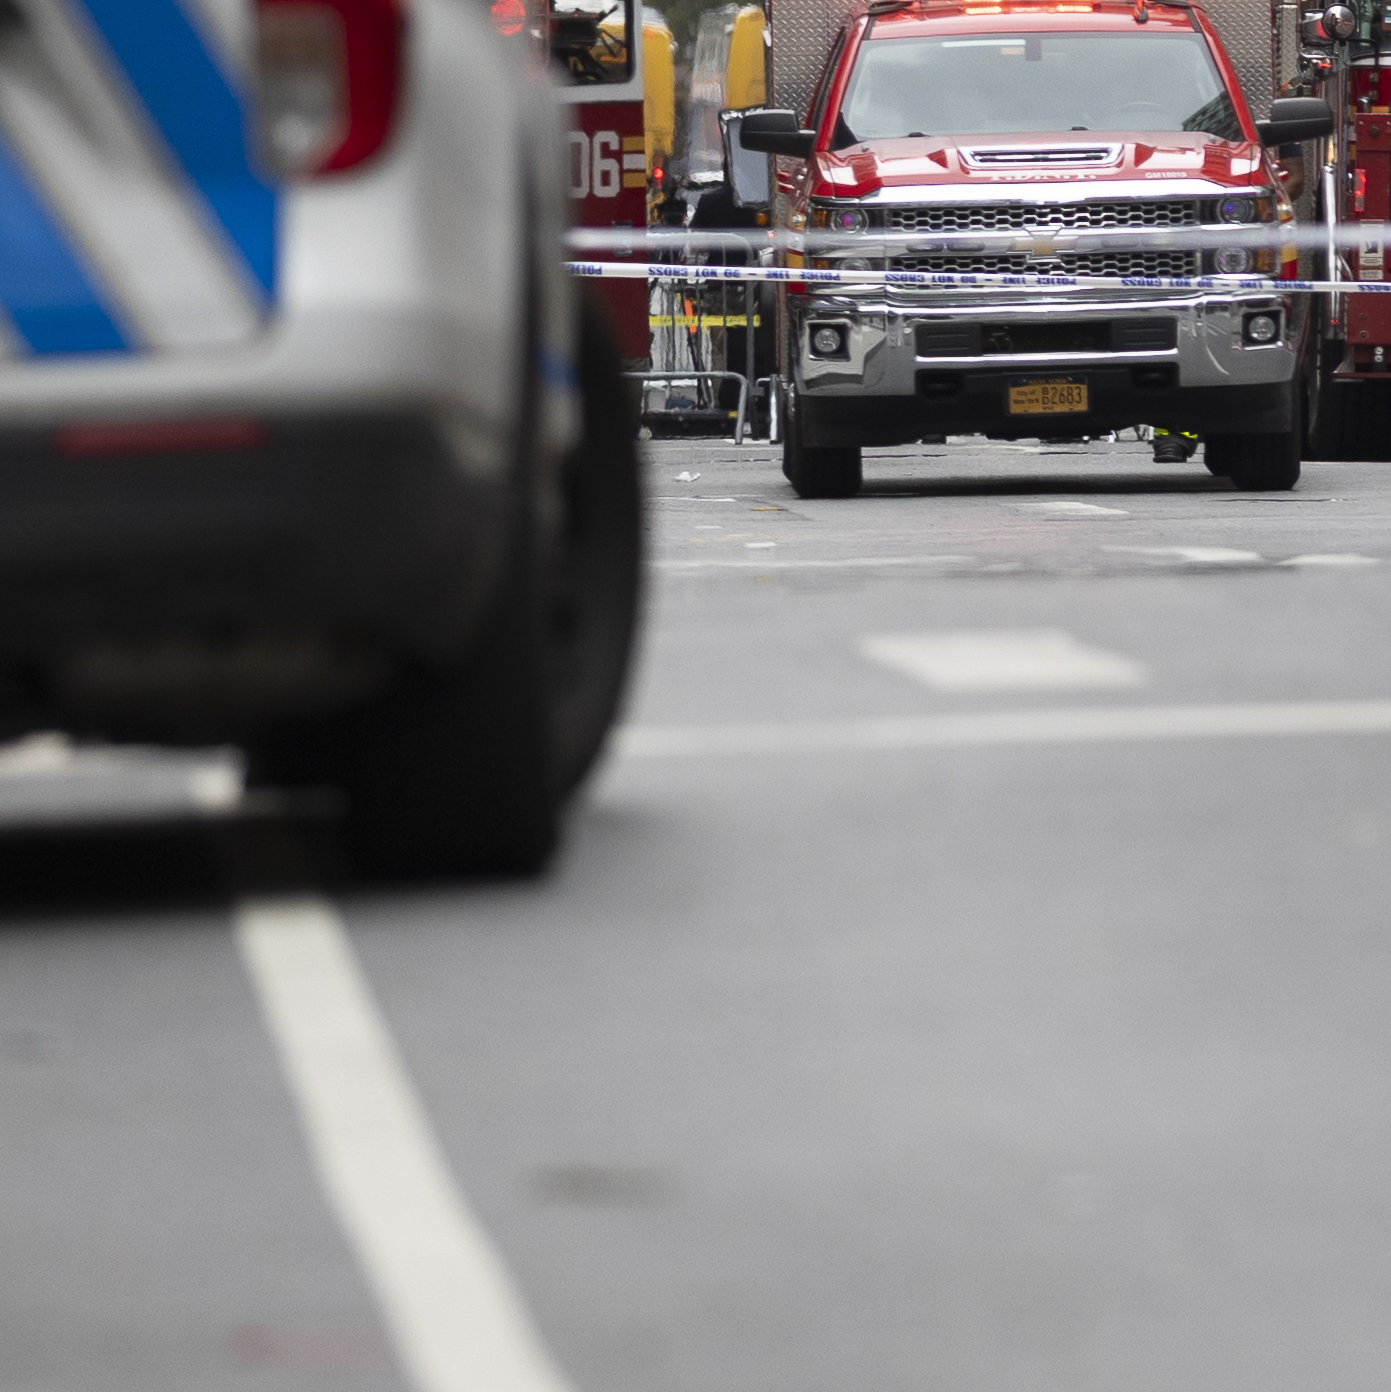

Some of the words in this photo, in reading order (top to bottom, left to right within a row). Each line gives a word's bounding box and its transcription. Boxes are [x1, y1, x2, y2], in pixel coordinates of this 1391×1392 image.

[648, 266, 688, 276] CROSS
[694, 268, 717, 277] NOT
[765, 270, 789, 279] LINE
[800, 271, 840, 280] POLICE
[885, 273, 925, 283] CROSS
[932, 274, 955, 283] NOT
[960, 275, 977, 284] DO
[1002, 276, 1027, 285] LINE
[1036, 277, 1076, 286] POLICE
[1120, 276, 1161, 286] CROSS
[1051, 386, 1082, 404] 2683
